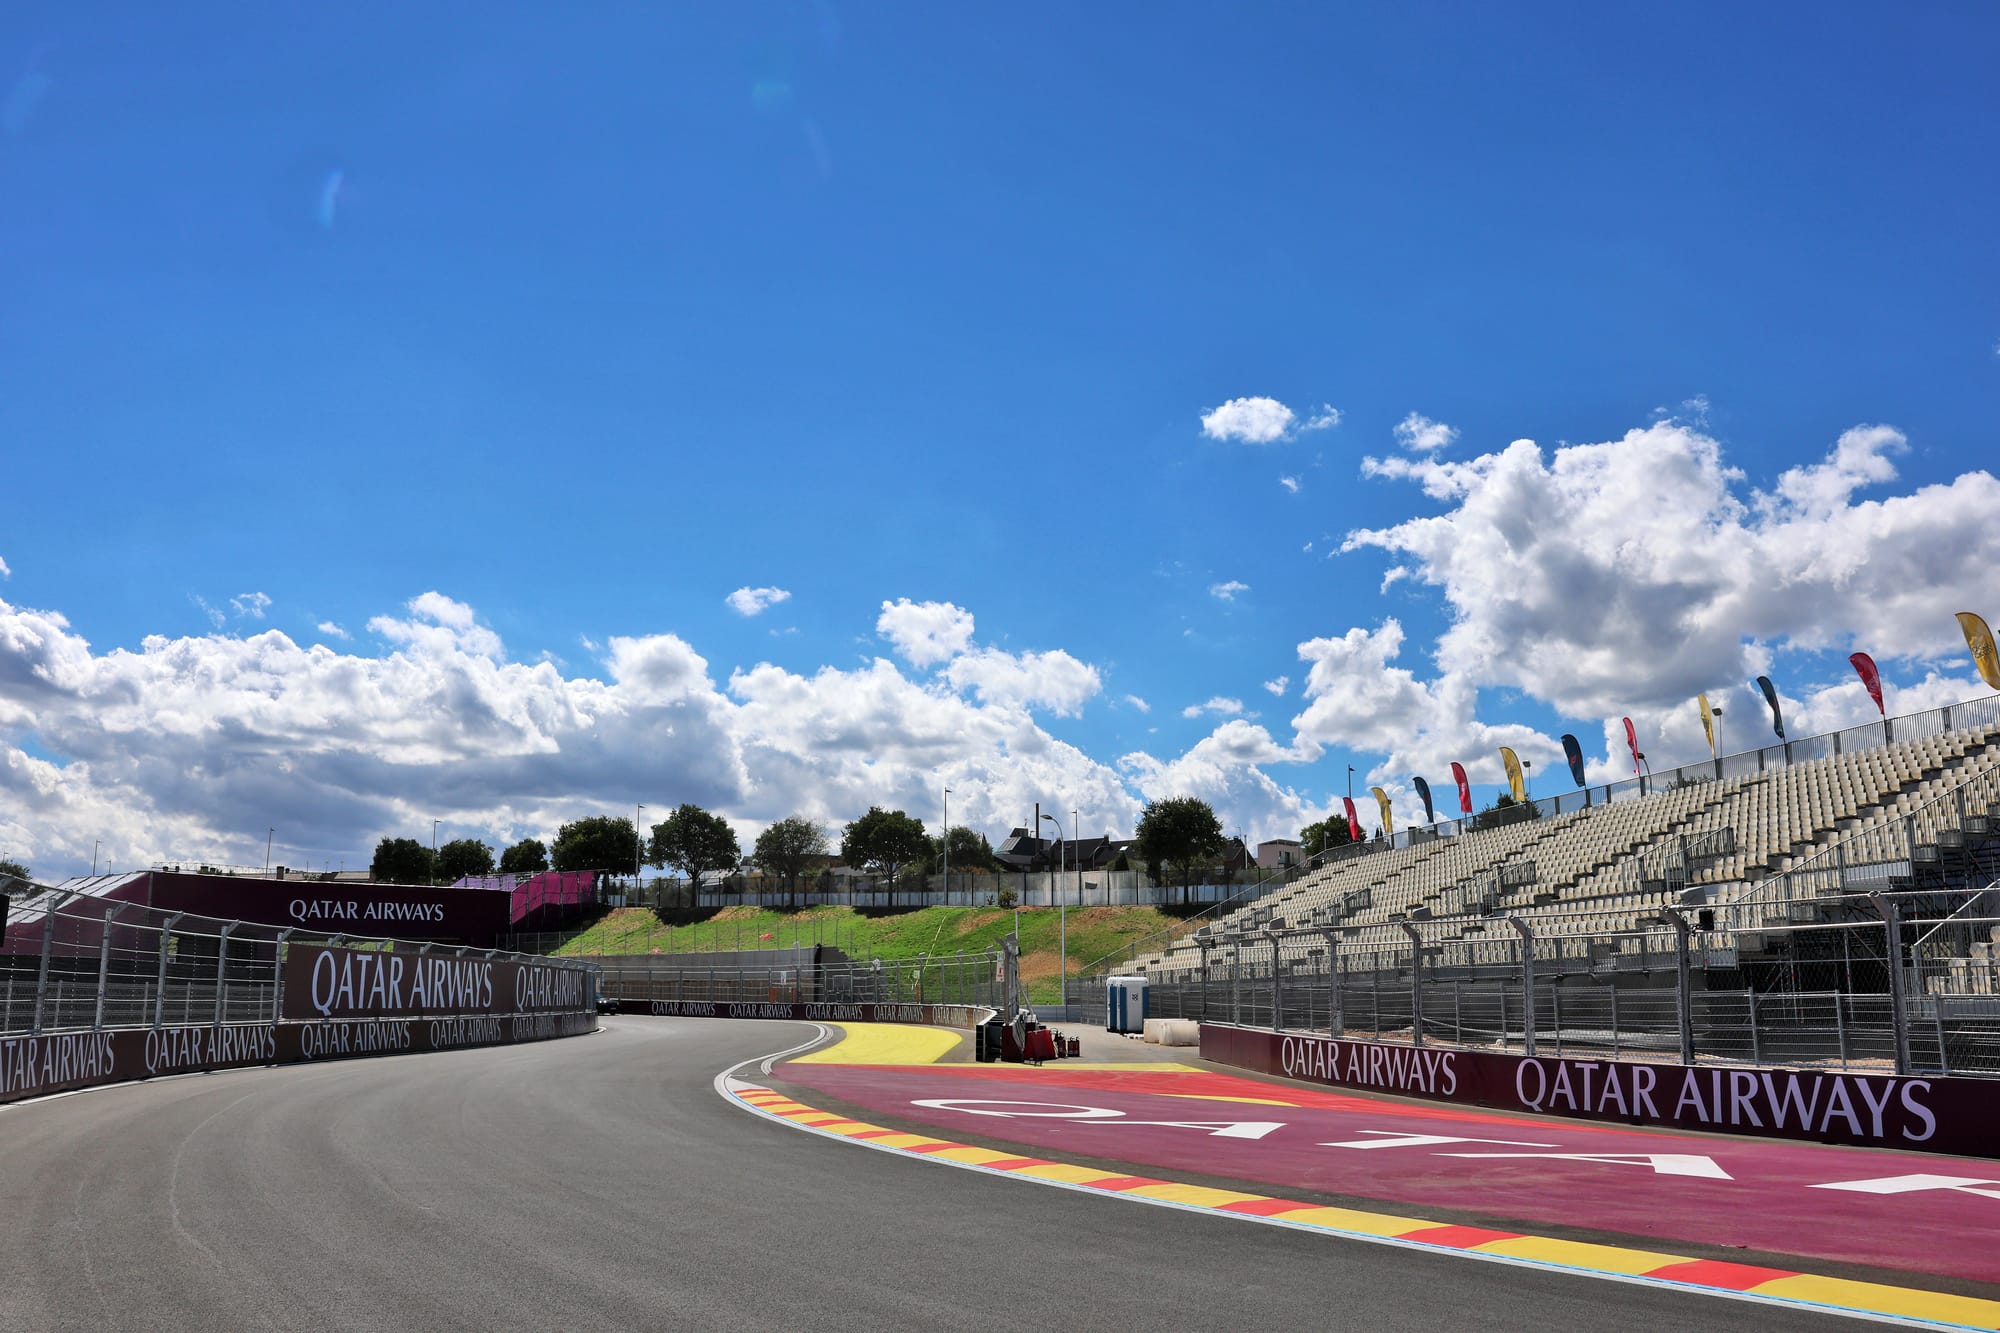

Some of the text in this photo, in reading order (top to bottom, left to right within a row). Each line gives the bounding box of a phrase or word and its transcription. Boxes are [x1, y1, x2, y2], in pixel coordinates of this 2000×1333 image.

[289, 899, 444, 922] QATAR AIRWAYS
[311, 950, 493, 1017] QATAR AIRWAYS
[516, 965, 584, 1012] QATAR AIRWAYS
[651, 1001, 716, 1017] QATAR AIRWAYS
[729, 1003, 793, 1019] QATAR AIRWAYS
[805, 1004, 863, 1020] QATAR AIRWAYS
[873, 1004, 924, 1023] QATAR AIRWAYS
[932, 1006, 950, 1025] QATAR
[301, 1021, 411, 1059] QATAR AIRWAYS
[430, 1018, 501, 1049] QATAR AIRWAYS
[512, 1015, 534, 1041] QATAR
[40, 1031, 115, 1086] AIRWAYS
[145, 1025, 276, 1074] QATAR AIRWAYS
[1281, 1036, 1457, 1096] QATAR AIRWAYS
[1515, 1058, 1937, 1142] QATAR AIRWAYS
